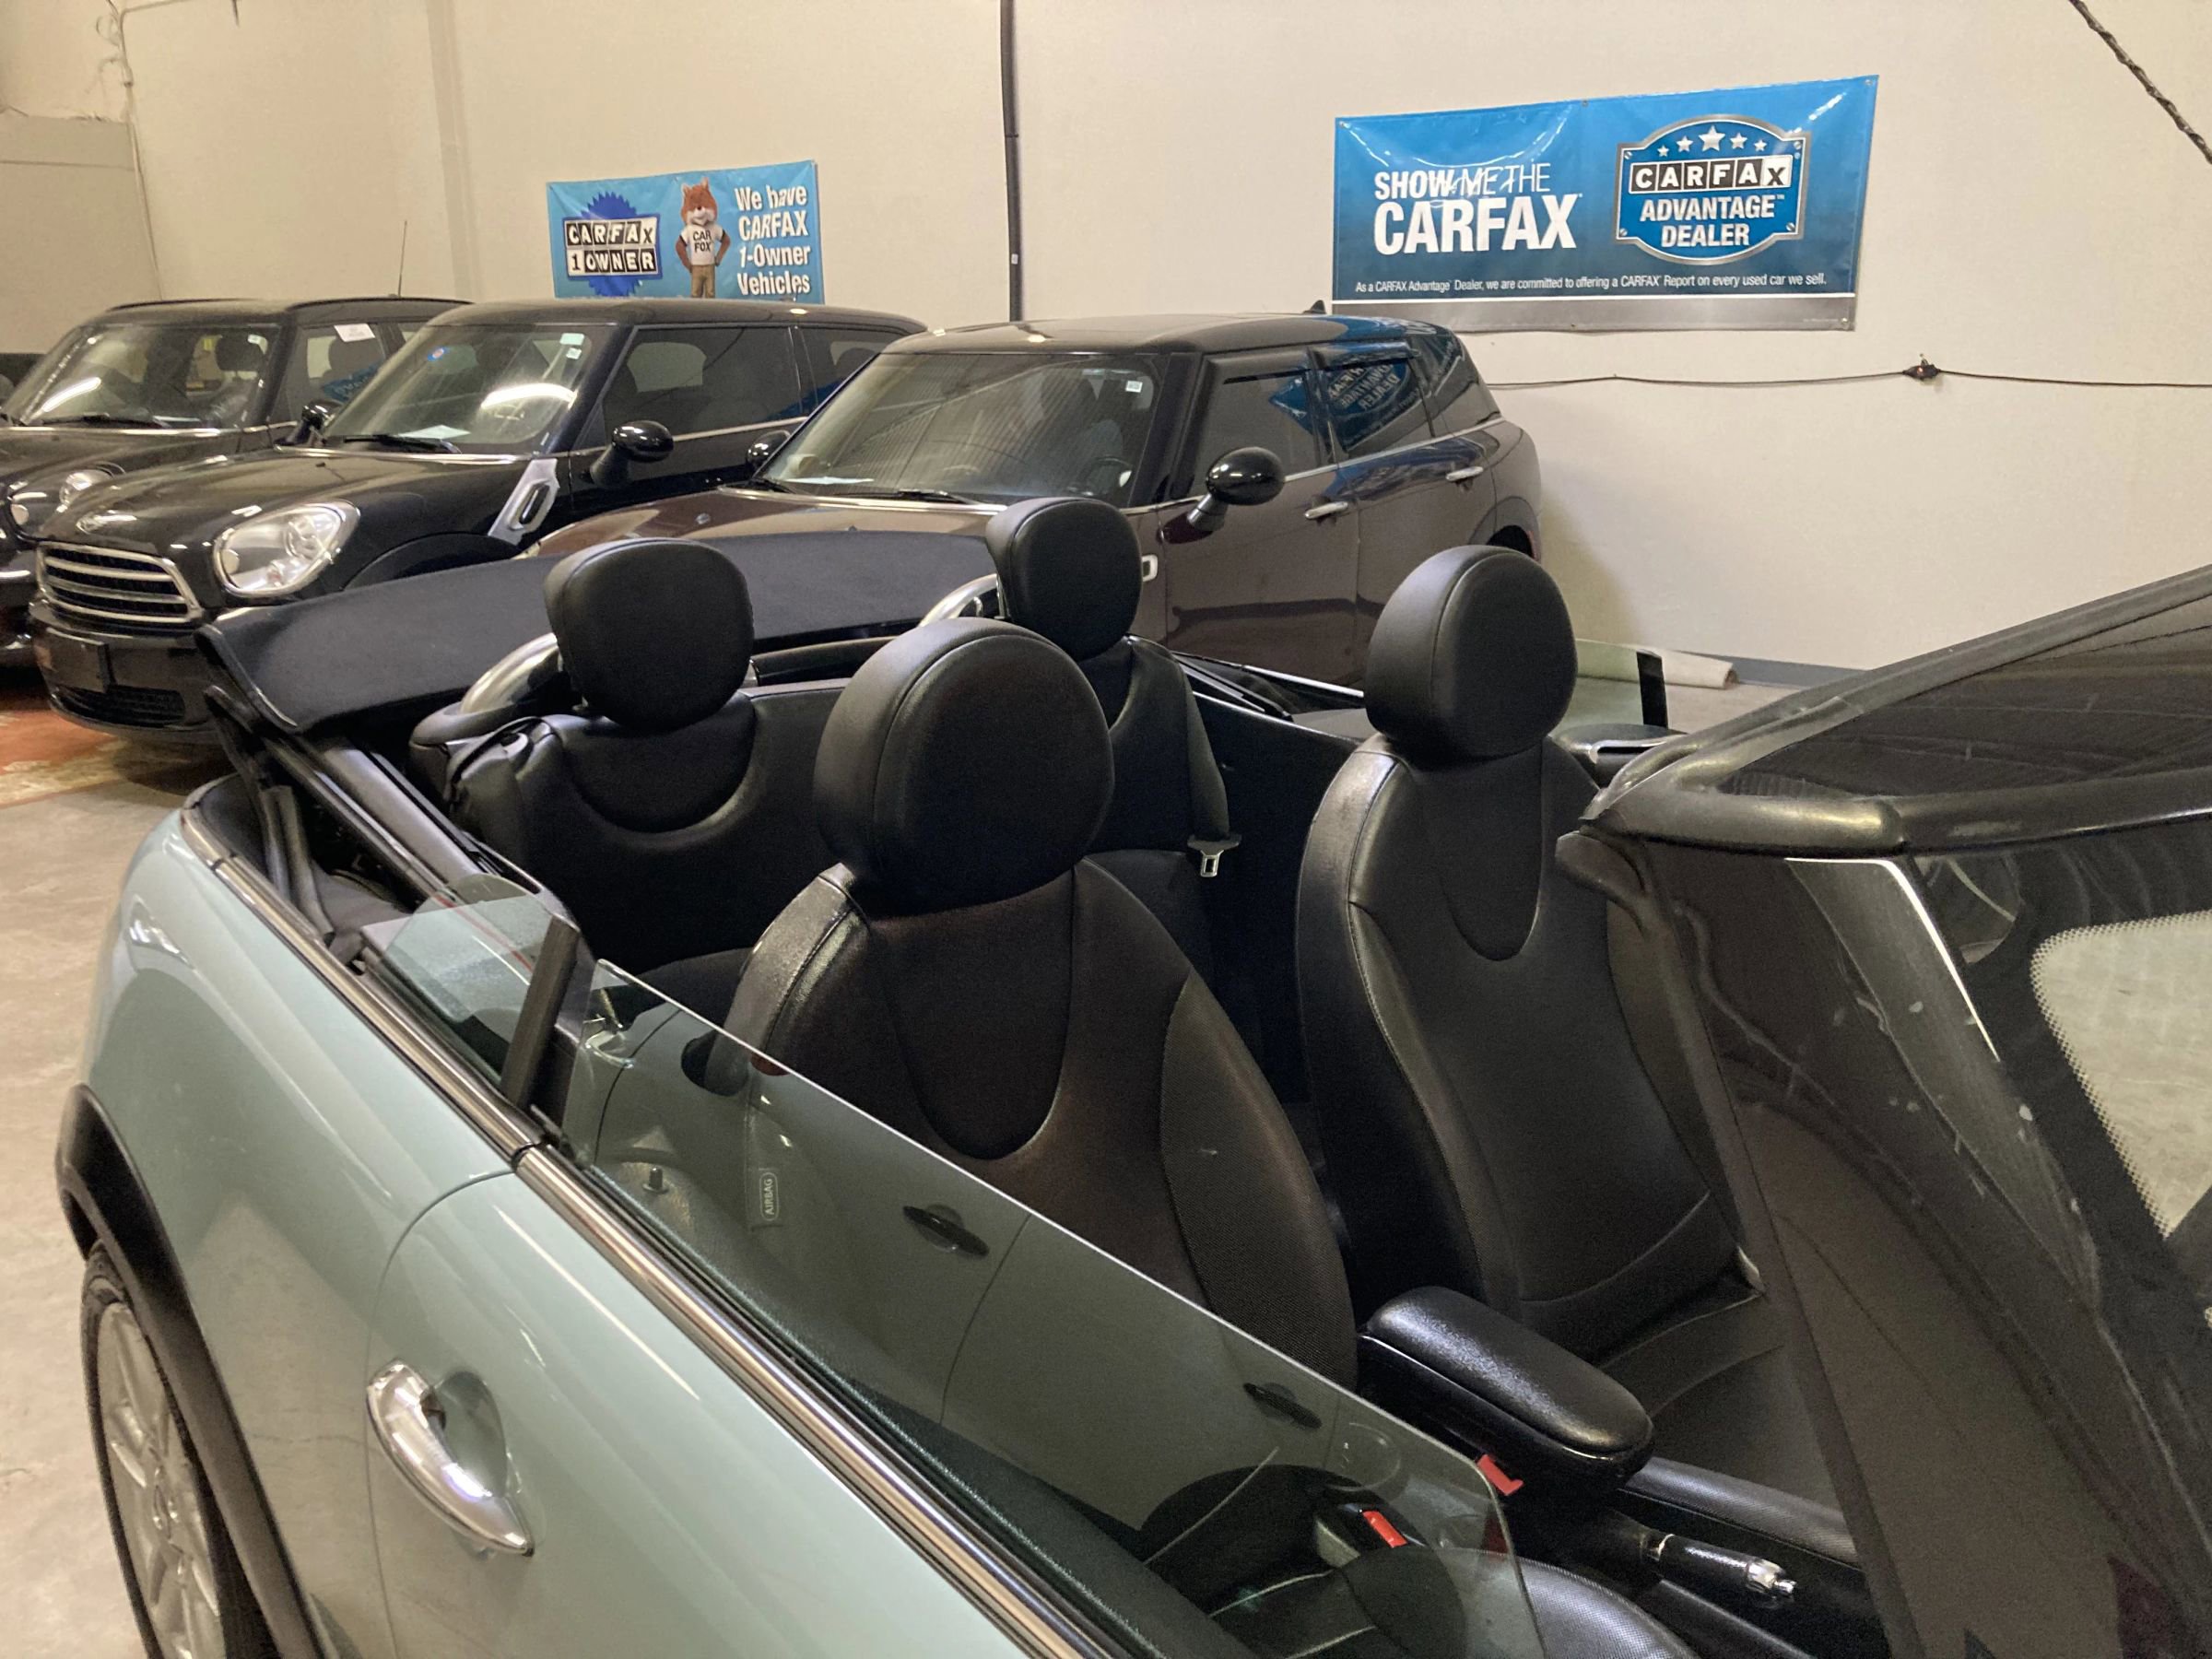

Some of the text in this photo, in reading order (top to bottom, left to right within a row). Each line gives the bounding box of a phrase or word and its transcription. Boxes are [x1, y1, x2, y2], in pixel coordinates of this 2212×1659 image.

[1374, 163, 1551, 200] SHOW ME THE
[1635, 163, 1787, 188] CARFAX
[735, 184, 807, 211] We have
[1640, 195, 1775, 222] ADVANTAGE
[568, 223, 654, 244] CARFAX
[693, 230, 712, 241] CAR
[739, 210, 808, 241] CARFAX
[1374, 194, 1578, 255] CARFAX
[1662, 224, 1750, 248] DEALER
[694, 241, 712, 253] FOX
[739, 244, 811, 267] 1-Owner
[572, 253, 654, 273] 1 OWNER
[737, 271, 811, 295] Vehicles
[1356, 273, 1827, 293] As a CARFAX Advantage Dealer, we are committed to offering a CARFAX Report on every used car we sell.
[764, 1179, 774, 1215] AIRBAG
